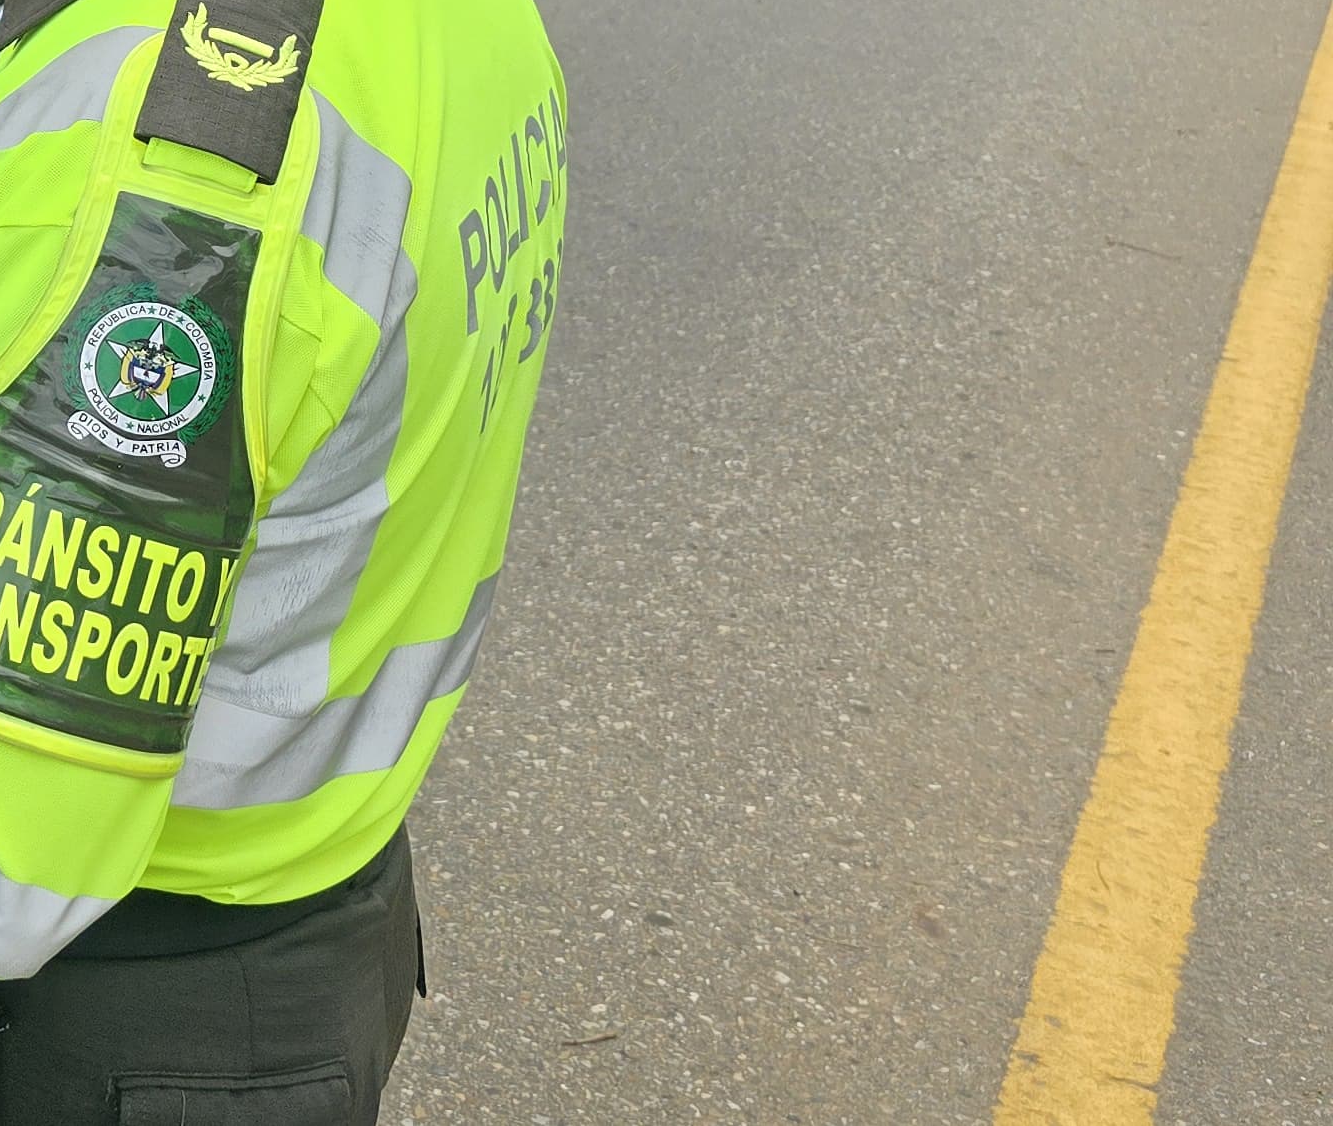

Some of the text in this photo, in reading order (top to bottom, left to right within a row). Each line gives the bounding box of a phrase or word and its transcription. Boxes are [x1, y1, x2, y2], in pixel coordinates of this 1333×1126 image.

[88, 305, 214, 382] REPUBLICA DE COLOMBIA
[78, 412, 181, 455] DIOS Y PATRIA
[137, 413, 189, 434] NACIONAL
[209, 557, 239, 627] Y
